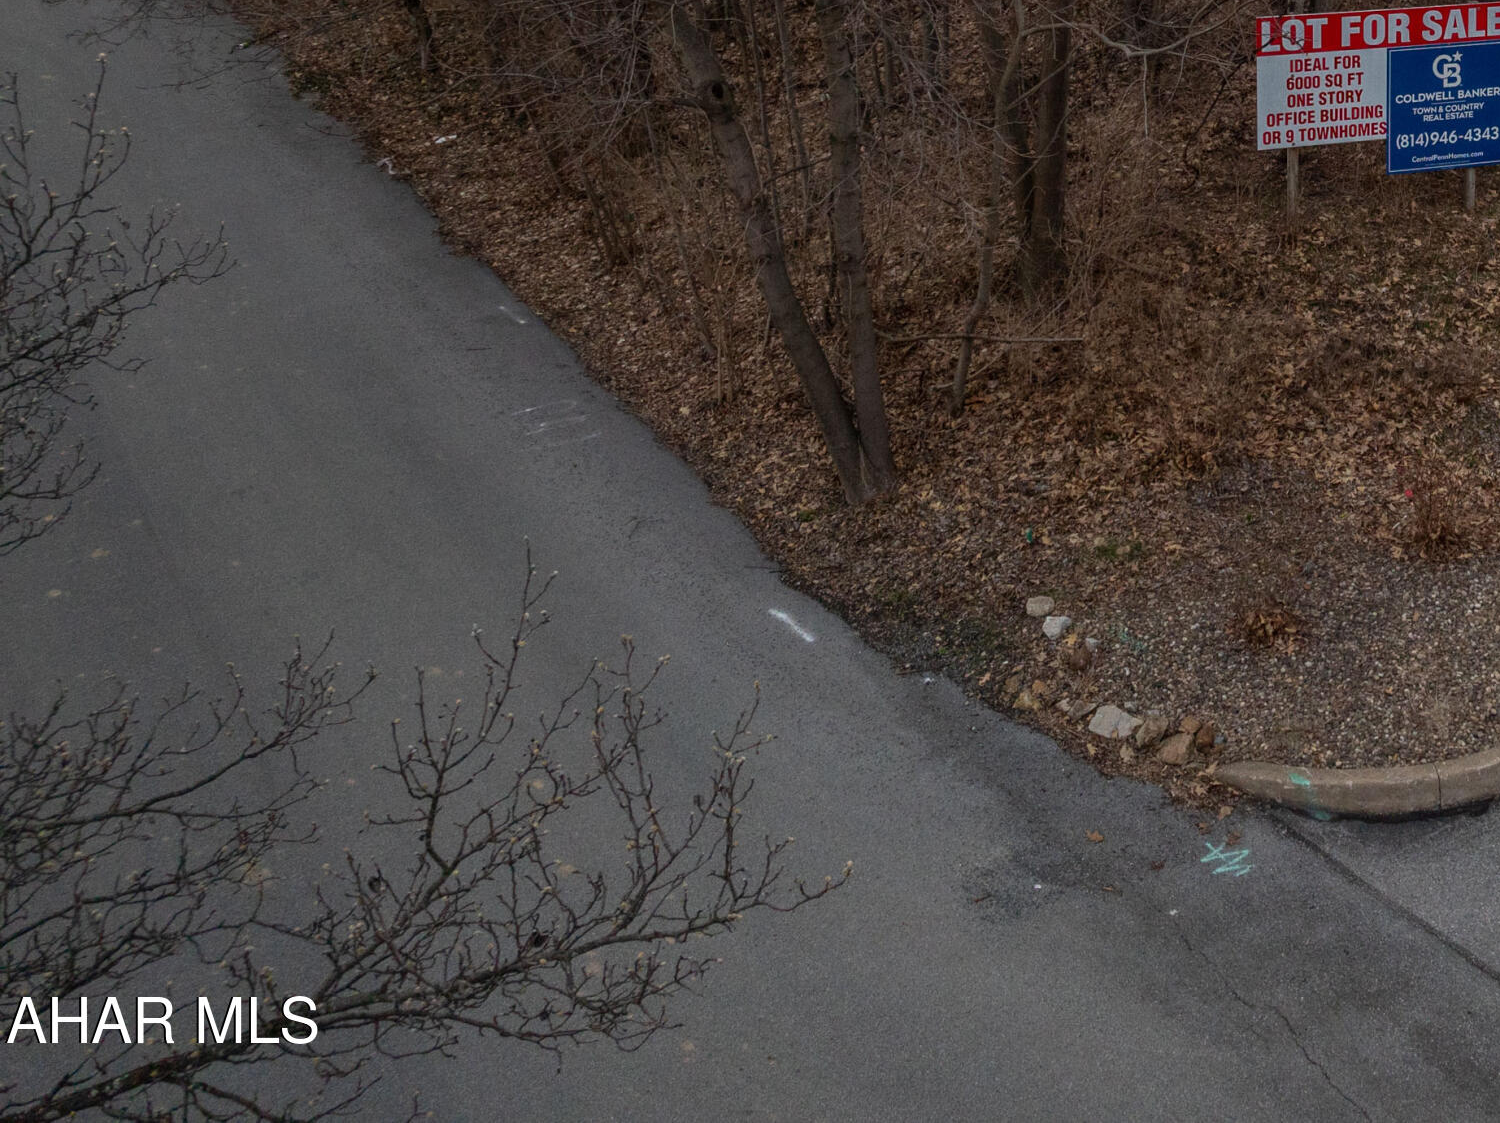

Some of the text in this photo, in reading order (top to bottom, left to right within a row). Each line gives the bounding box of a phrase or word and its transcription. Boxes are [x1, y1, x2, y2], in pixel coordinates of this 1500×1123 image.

[1260, 17, 1328, 53] LOT
[1341, 13, 1410, 47] FOR
[1290, 55, 1361, 73] IDEAL FOR
[1286, 72, 1364, 90] 6000 SQ FT
[1287, 89, 1363, 108] ONE STORY
[1395, 86, 1500, 104] COLDWELL BANKER
[1266, 105, 1383, 127] OFFICE BUILDING
[1412, 107, 1437, 115] TOWN
[1445, 102, 1485, 112] COUNTRY
[1423, 111, 1474, 122] REAL ESTATE
[1262, 122, 1387, 145] OR 9 TOWNHOMES
[1396, 126, 1499, 149] (814)946-4343
[1411, 151, 1484, 163] CentralPennHomes.com
